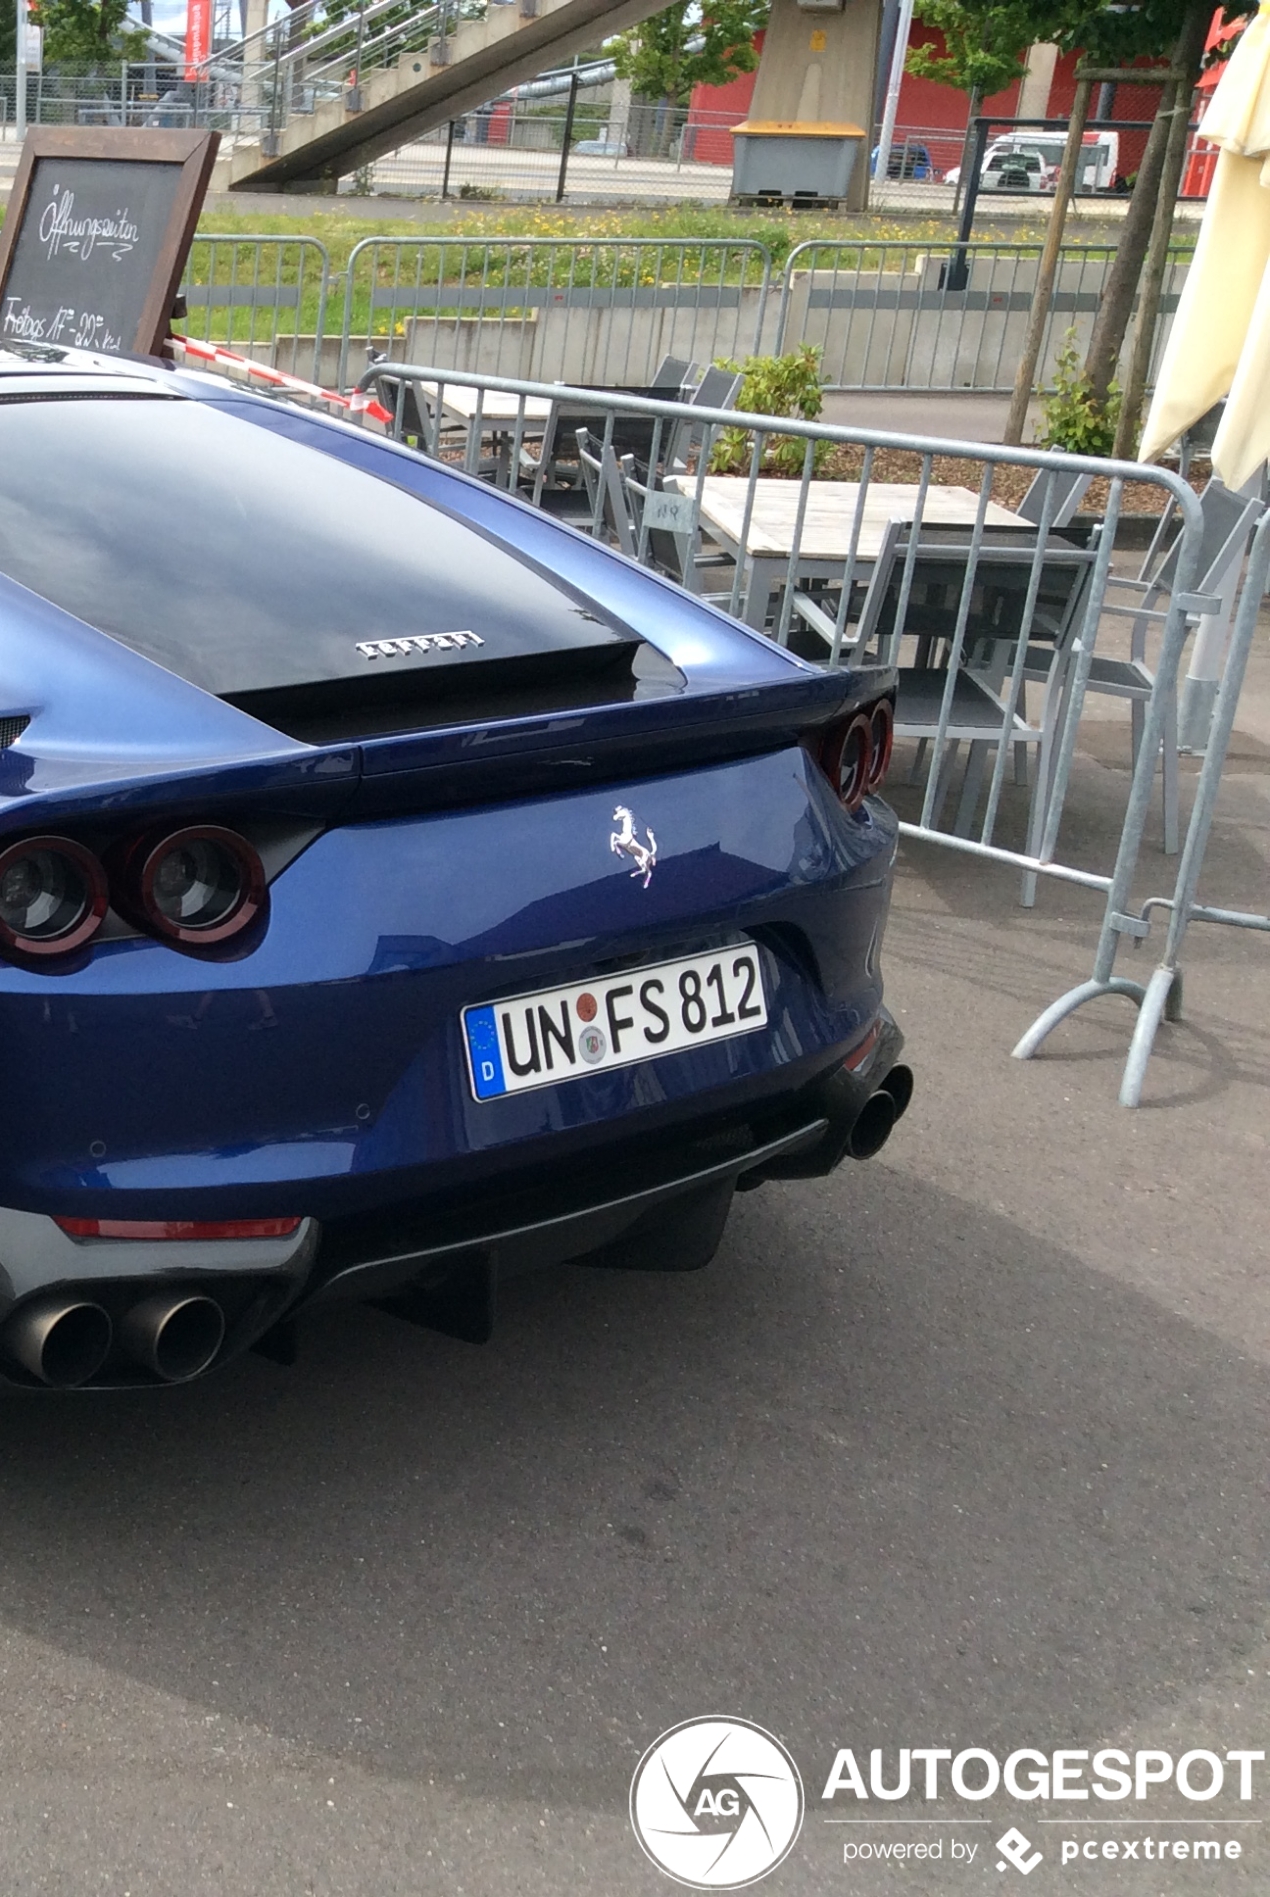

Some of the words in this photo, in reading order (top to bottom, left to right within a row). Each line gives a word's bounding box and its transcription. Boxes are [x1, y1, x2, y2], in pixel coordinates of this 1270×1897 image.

[502, 1000, 576, 1077] UN
[605, 979, 670, 1054] FS
[678, 956, 762, 1034] 812
[481, 1061, 495, 1081] D
